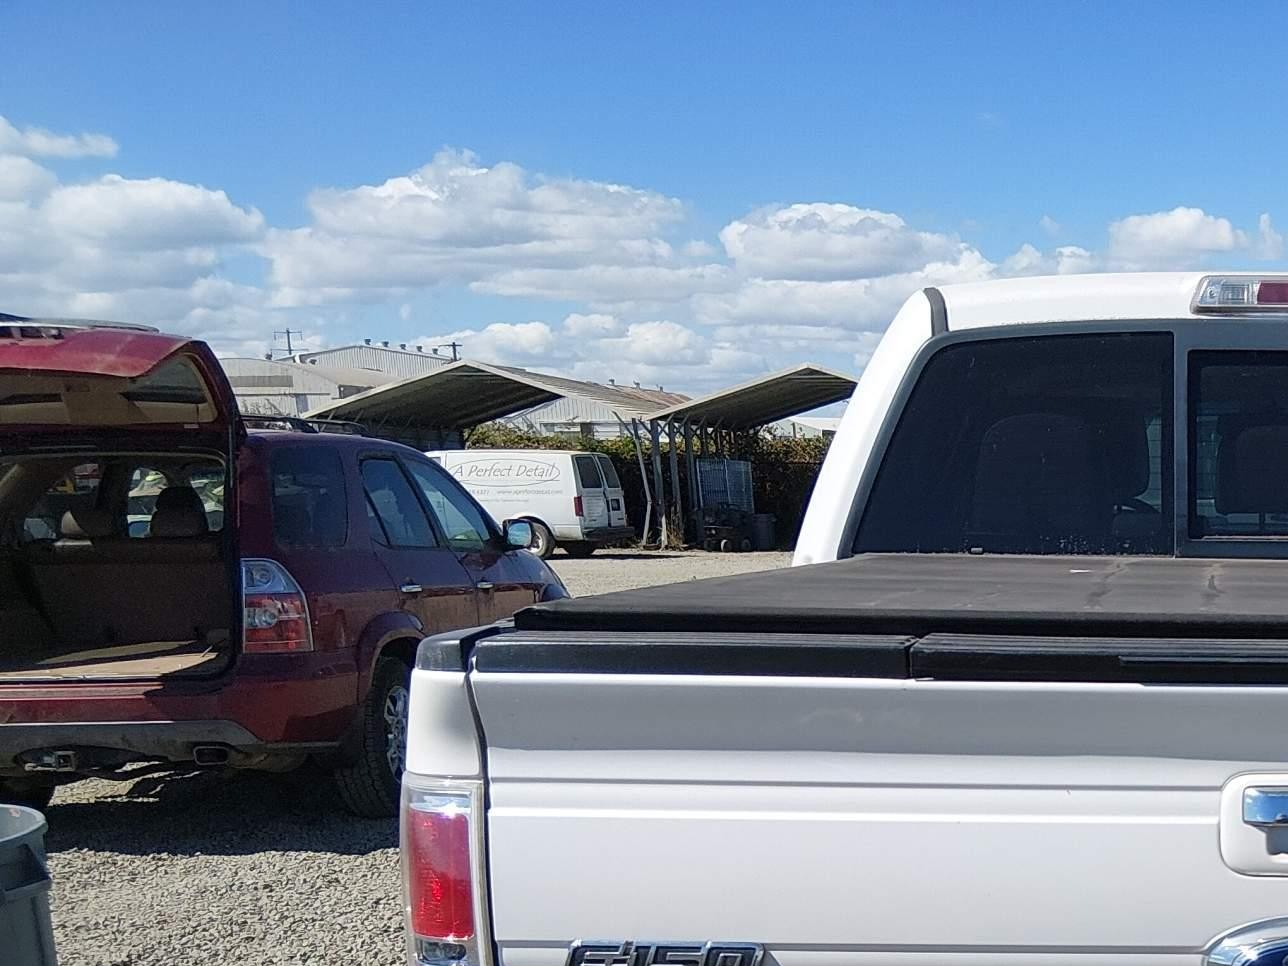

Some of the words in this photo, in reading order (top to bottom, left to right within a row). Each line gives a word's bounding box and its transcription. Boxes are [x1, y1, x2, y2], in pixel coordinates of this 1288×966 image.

[453, 464, 464, 477] A
[468, 462, 513, 477] Perfect
[516, 462, 556, 478] Detail
